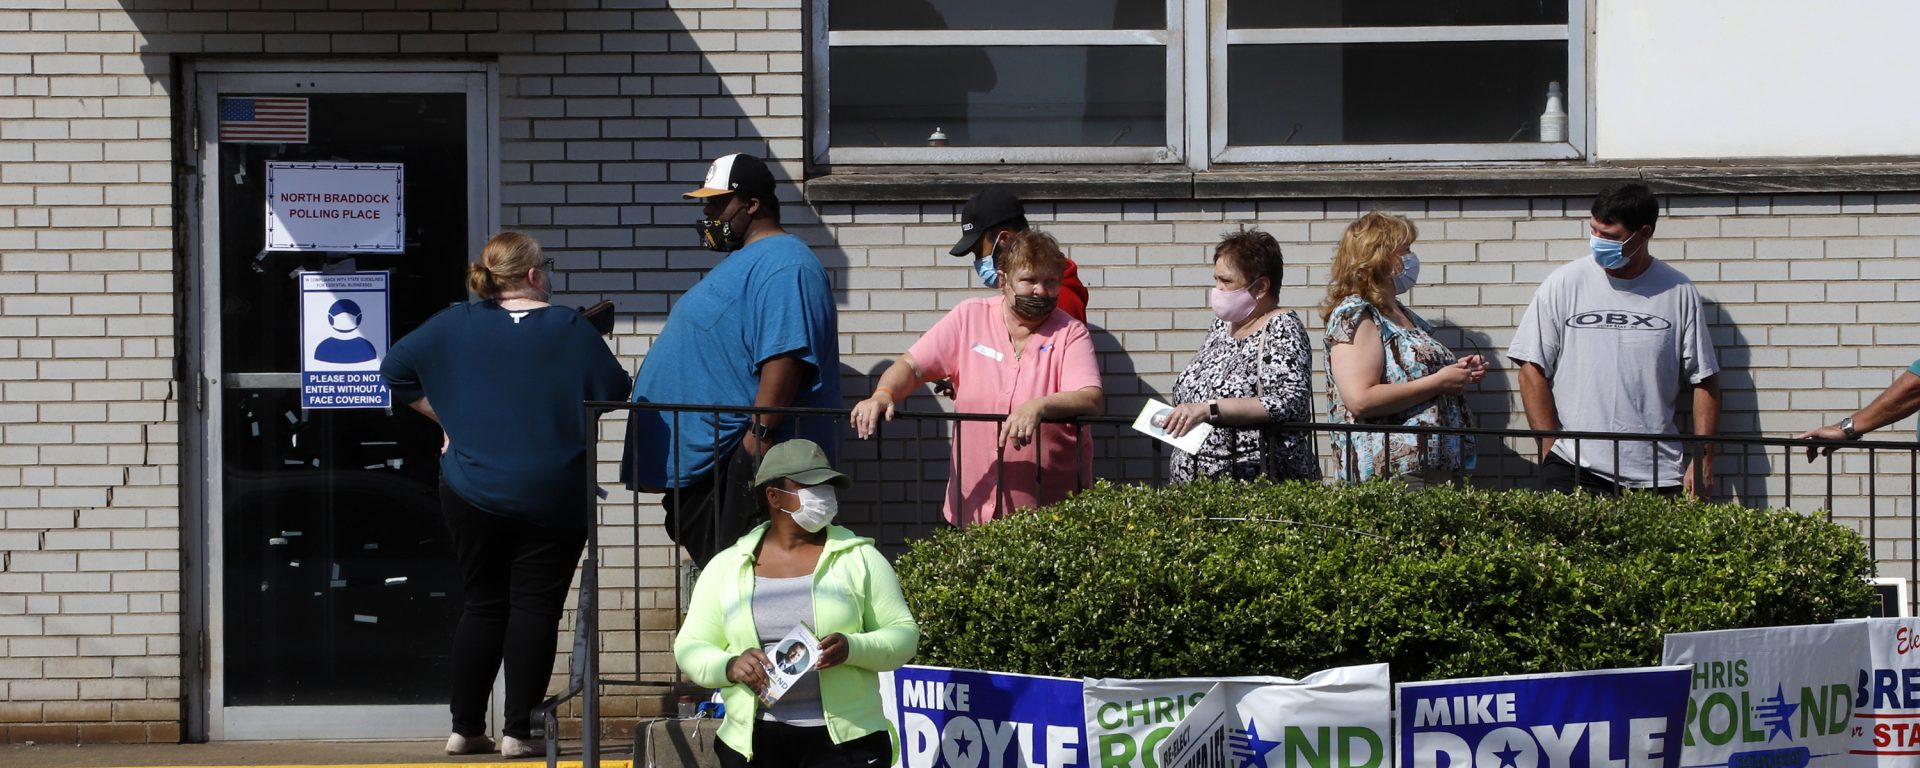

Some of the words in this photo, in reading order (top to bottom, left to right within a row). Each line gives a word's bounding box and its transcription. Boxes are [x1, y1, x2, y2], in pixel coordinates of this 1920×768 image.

[281, 193, 320, 203] NORTH
[324, 194, 389, 204] BRADDOCK
[290, 209, 339, 219] POLLING
[343, 210, 380, 219] PLACE
[1576, 313, 1654, 328] OBX
[305, 386, 335, 394] ENTER
[337, 385, 378, 393] WITHOUT
[380, 385, 387, 393] A
[310, 375, 345, 383] PLEASE
[347, 375, 360, 383] DO
[362, 374, 381, 382] NOT
[310, 396, 334, 404] FACE
[336, 395, 382, 404] COVERING
[1692, 659, 1749, 690] HRIS
[903, 680, 970, 712] MIKE
[1413, 692, 1516, 728] MIKE
[903, 711, 1080, 768] DOYLE
[1163, 724, 1191, 768] RE-ELECT
[1413, 716, 1668, 768] DOYLE
